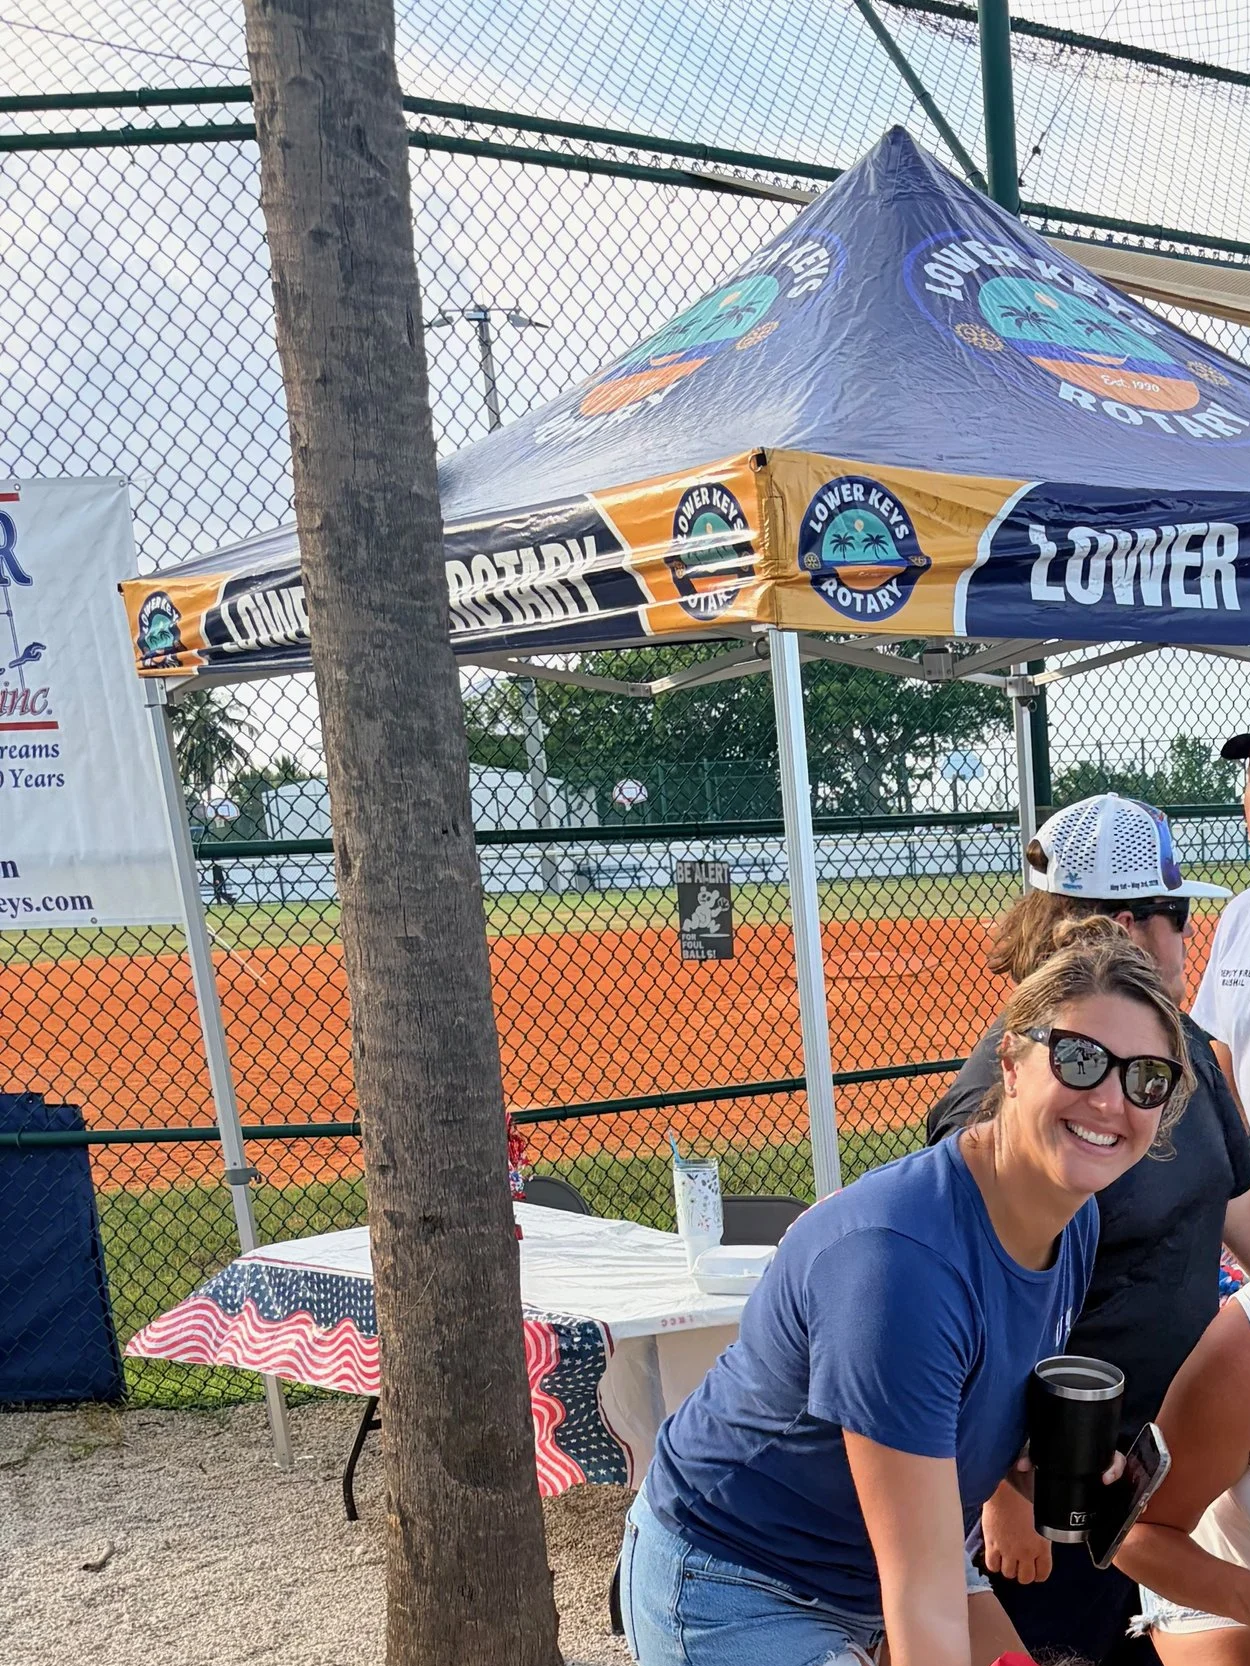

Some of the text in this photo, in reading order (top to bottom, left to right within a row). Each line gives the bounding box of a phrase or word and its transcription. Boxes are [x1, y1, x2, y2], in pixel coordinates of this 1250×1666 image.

[923, 240, 1162, 335] LOWER KEYS
[1132, 379, 1161, 393] 1990
[1058, 381, 1250, 439] ROTARY
[810, 484, 910, 541] LOWER KEYS
[1028, 522, 1240, 610] LOWER
[448, 535, 598, 632] ROTARY
[820, 578, 902, 614] ROTARY
[220, 586, 311, 652] LOWE
[0, 743, 60, 759] reams
[9, 769, 65, 788] Years
[676, 863, 729, 883] BE ALERT
[0, 895, 94, 918] eys.com
[682, 941, 704, 949] FOUL
[682, 950, 717, 959] BALLS!
